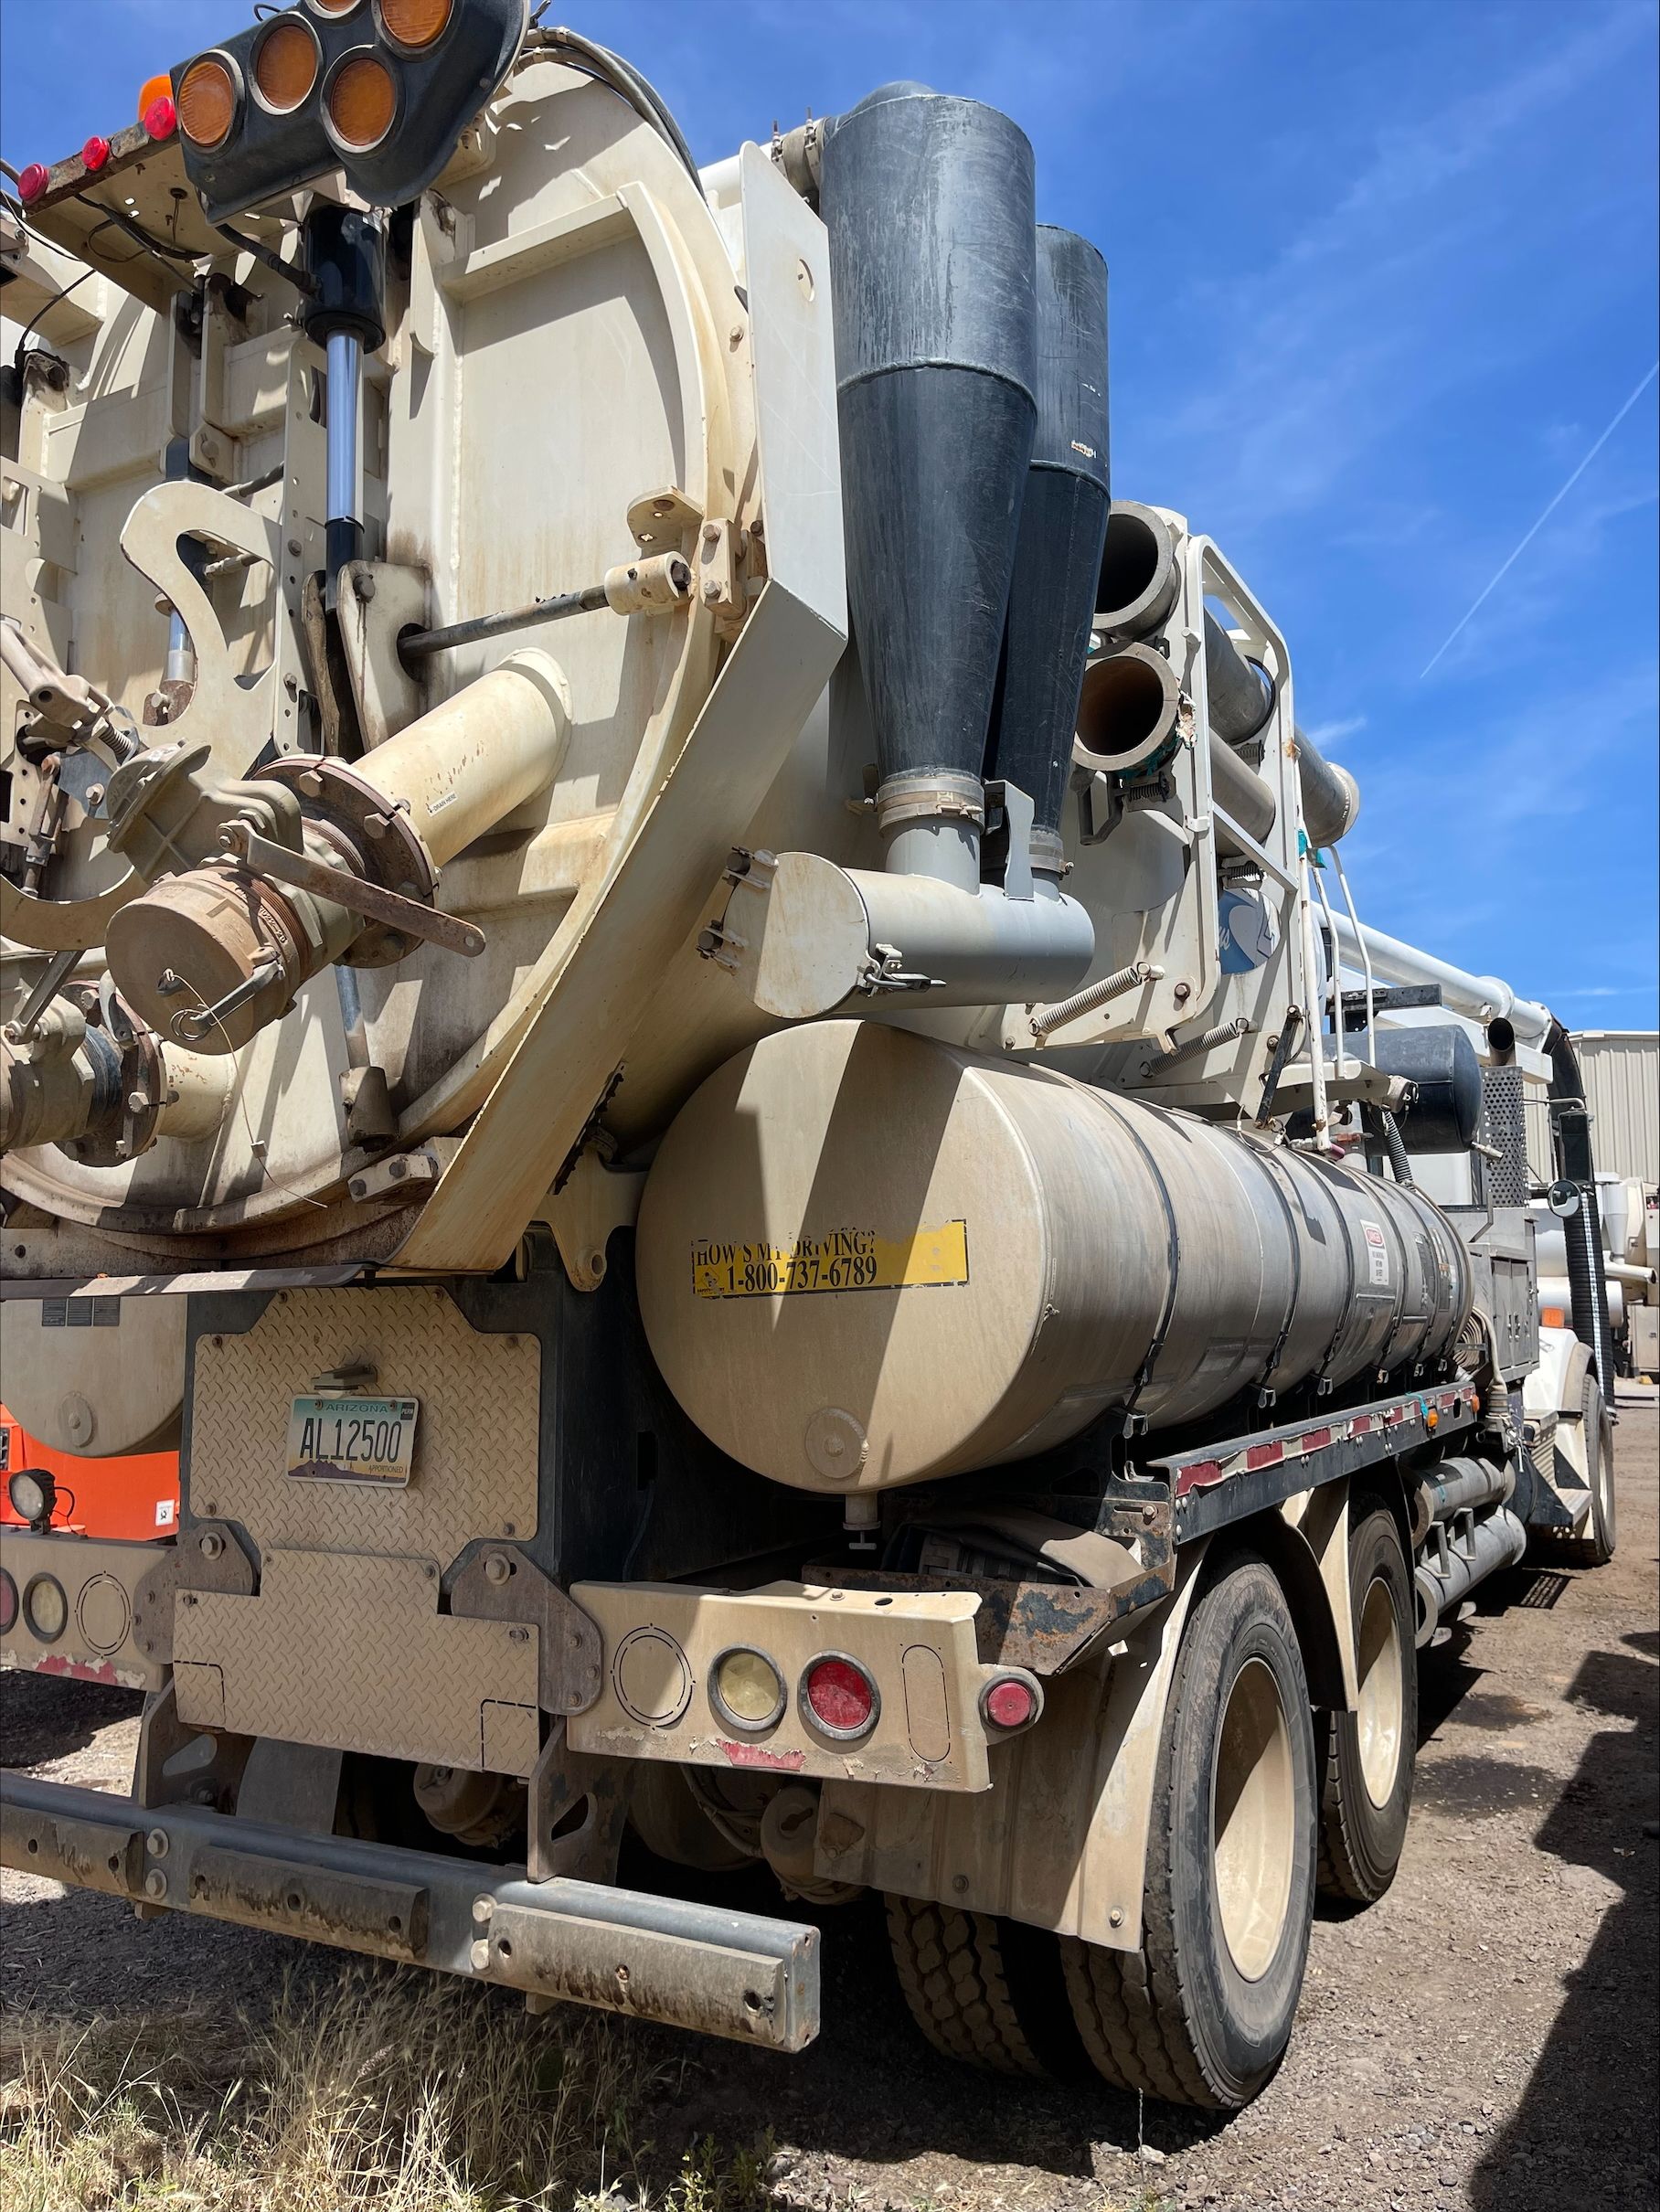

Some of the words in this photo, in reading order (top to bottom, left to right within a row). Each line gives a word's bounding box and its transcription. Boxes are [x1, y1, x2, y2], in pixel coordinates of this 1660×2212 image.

[727, 1256, 878, 1292] 1-800-737-6789
[325, 1403, 388, 1413] ARIZONA
[299, 1418, 403, 1462] AL12500
[368, 1464, 404, 1473] APPORTIONED
